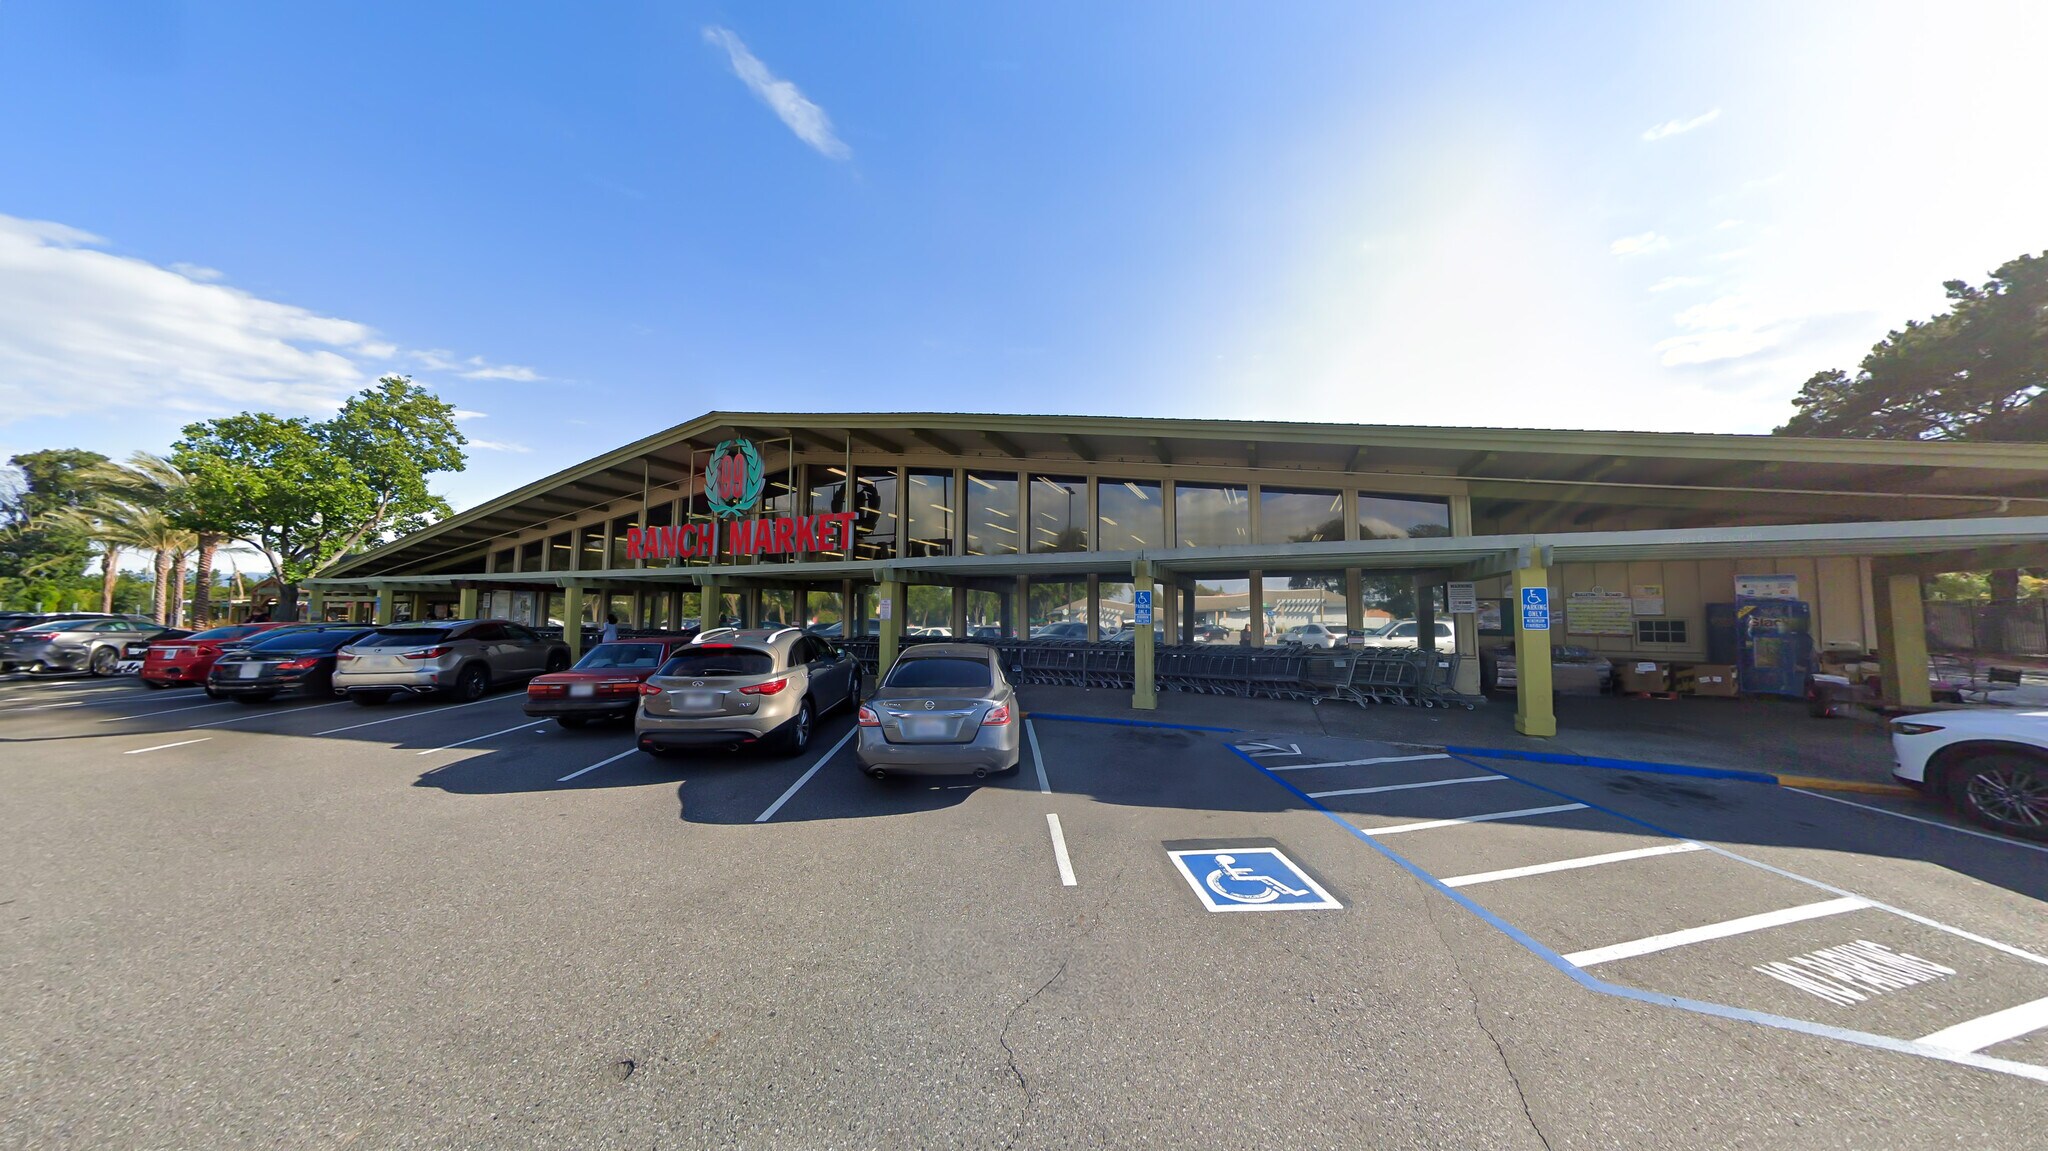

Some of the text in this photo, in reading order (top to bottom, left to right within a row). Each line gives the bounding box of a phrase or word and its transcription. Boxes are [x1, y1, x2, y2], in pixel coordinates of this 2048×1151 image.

[720, 454, 746, 498] 99
[627, 512, 858, 559] RANCH MARKET
